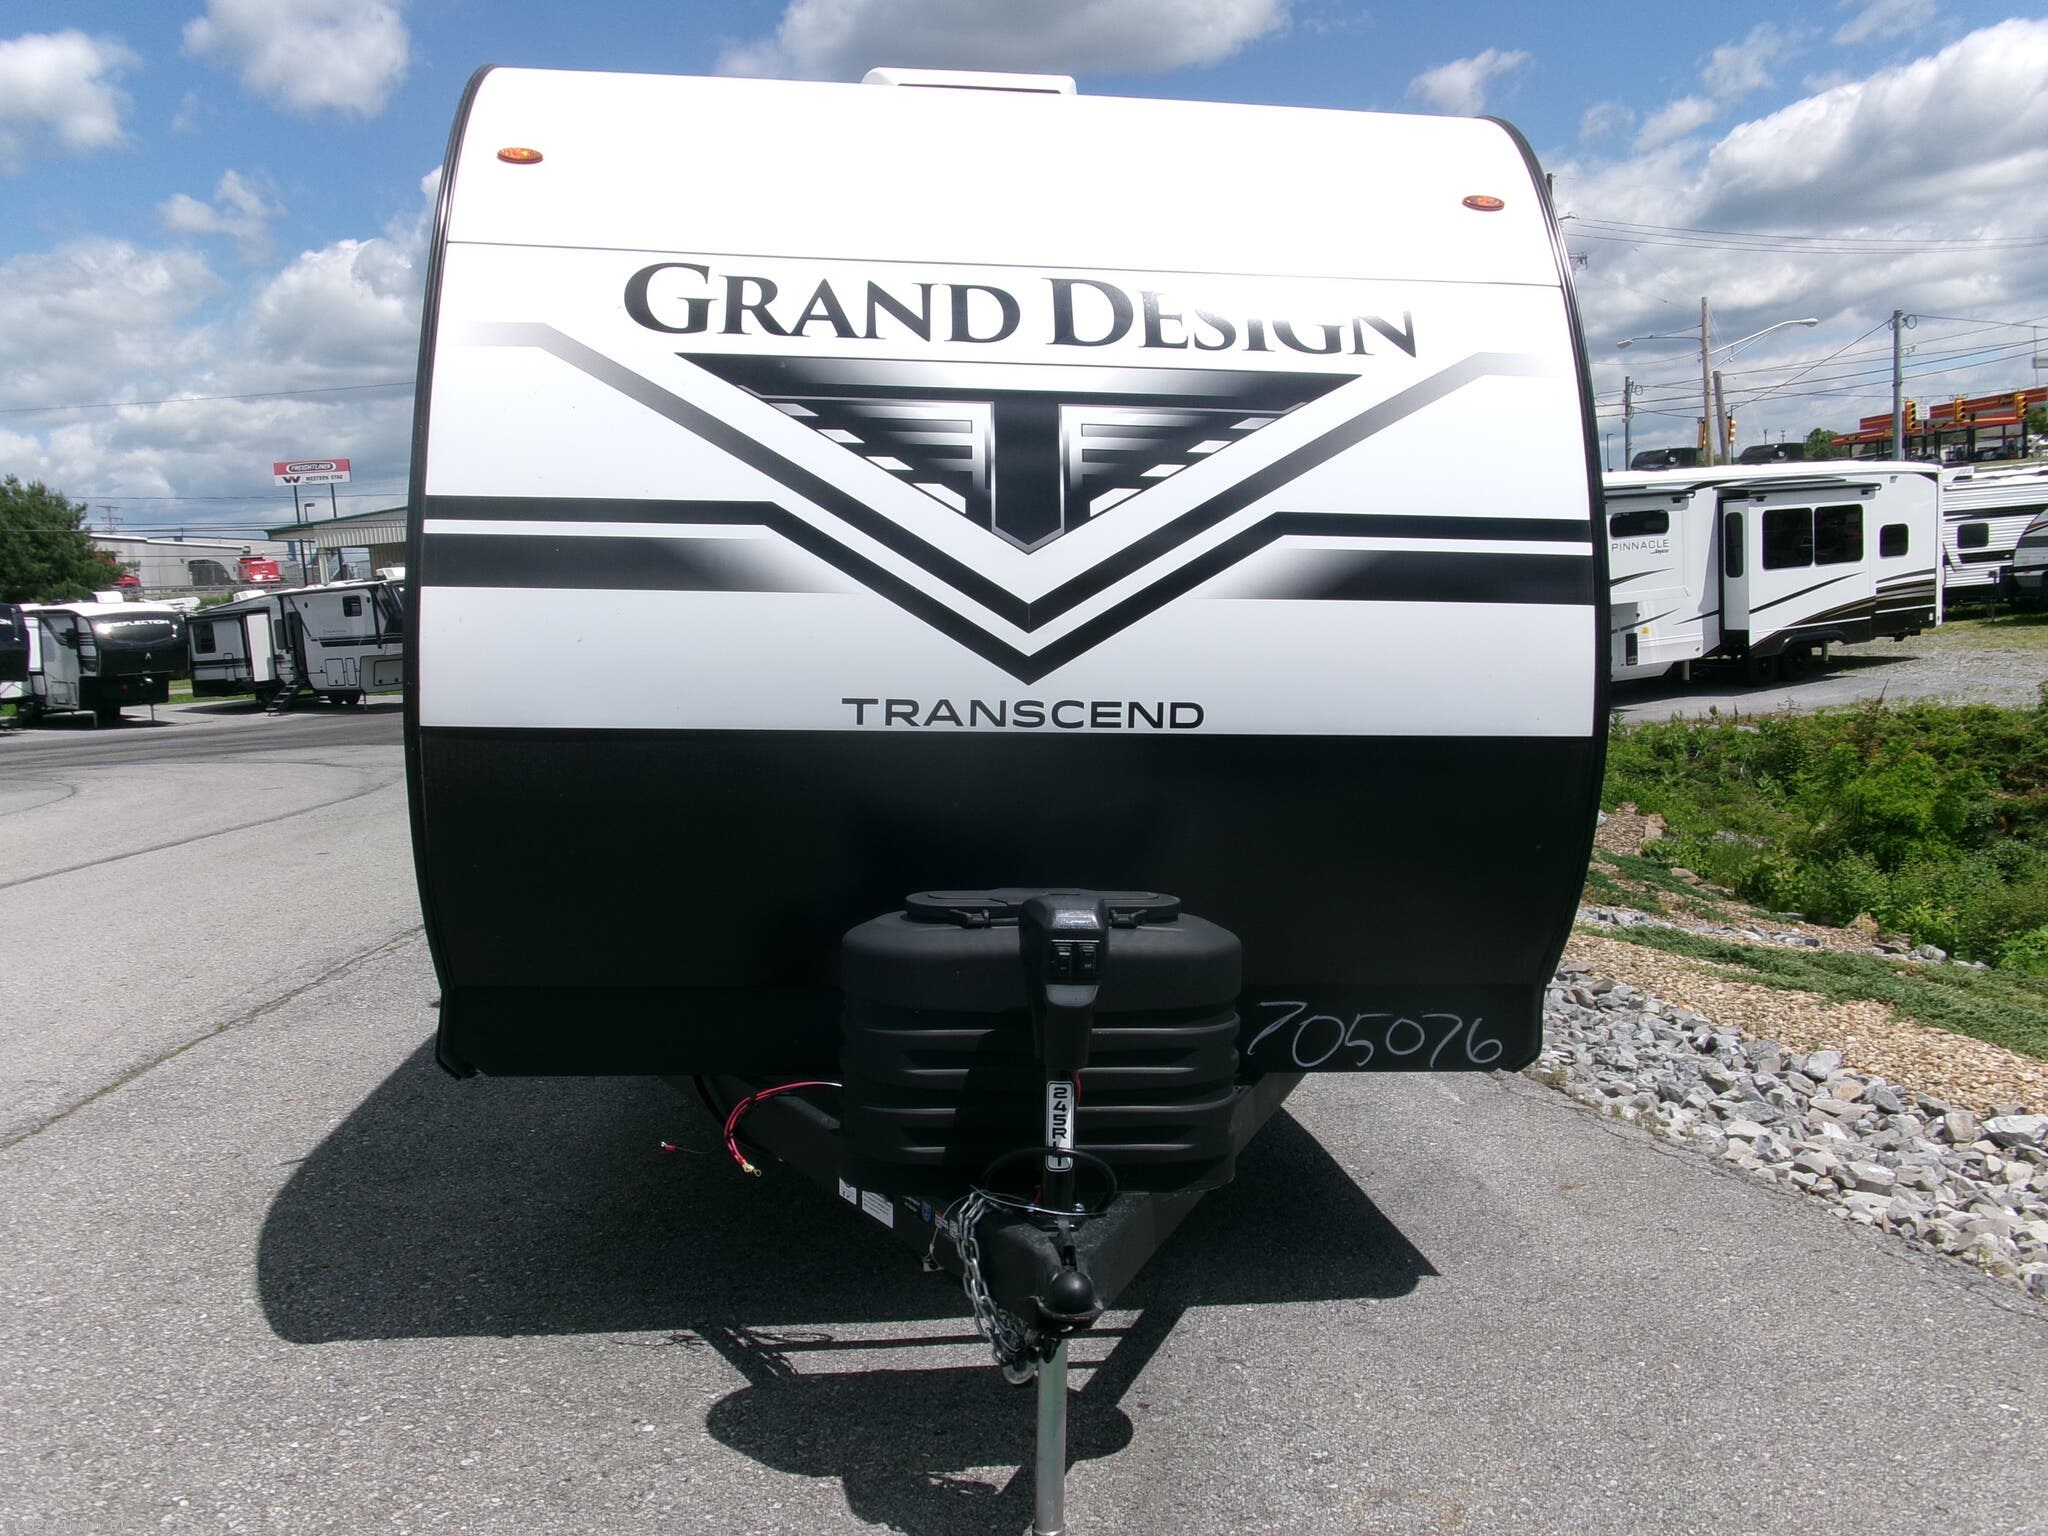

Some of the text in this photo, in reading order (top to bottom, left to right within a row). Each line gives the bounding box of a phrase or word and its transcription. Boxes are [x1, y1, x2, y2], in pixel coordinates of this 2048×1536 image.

[624, 262, 1417, 358] GRAND DESIGN
[1611, 540, 1669, 552] PINNACLE
[841, 697, 1205, 730] TRANSCEND
[1247, 1001, 1503, 1068] 705076
